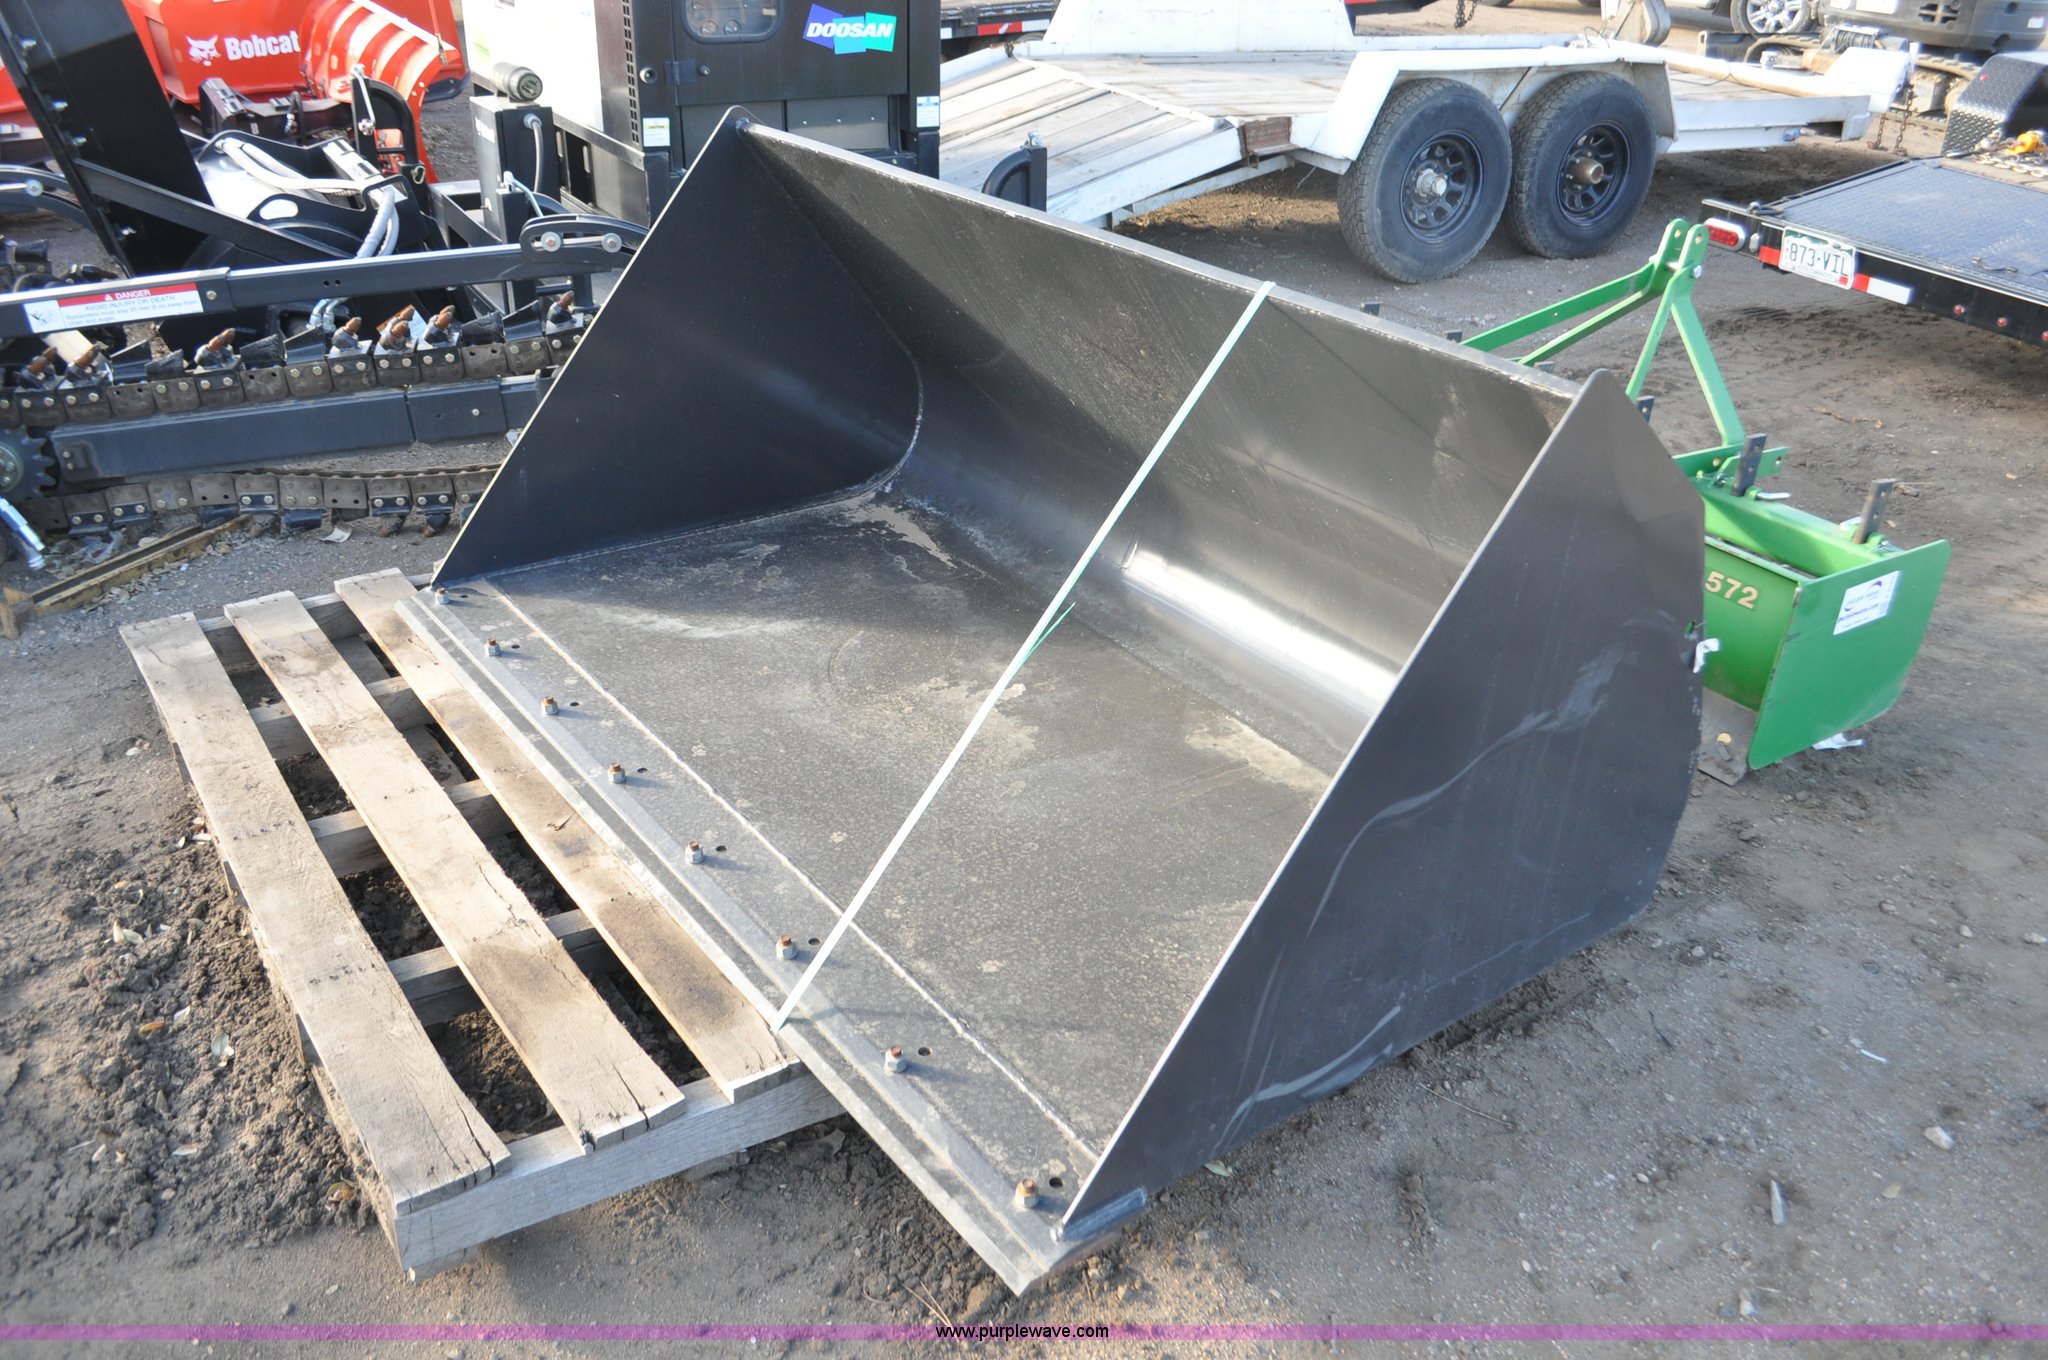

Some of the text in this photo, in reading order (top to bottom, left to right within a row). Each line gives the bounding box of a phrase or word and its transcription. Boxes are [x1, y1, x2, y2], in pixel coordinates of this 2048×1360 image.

[806, 22, 894, 38] DOOSAN
[224, 30, 301, 61] Bobcat
[115, 289, 151, 300] DANGER
[85, 295, 176, 312] AVOID INJURY OR DEATH
[1705, 571, 1758, 609] 572
